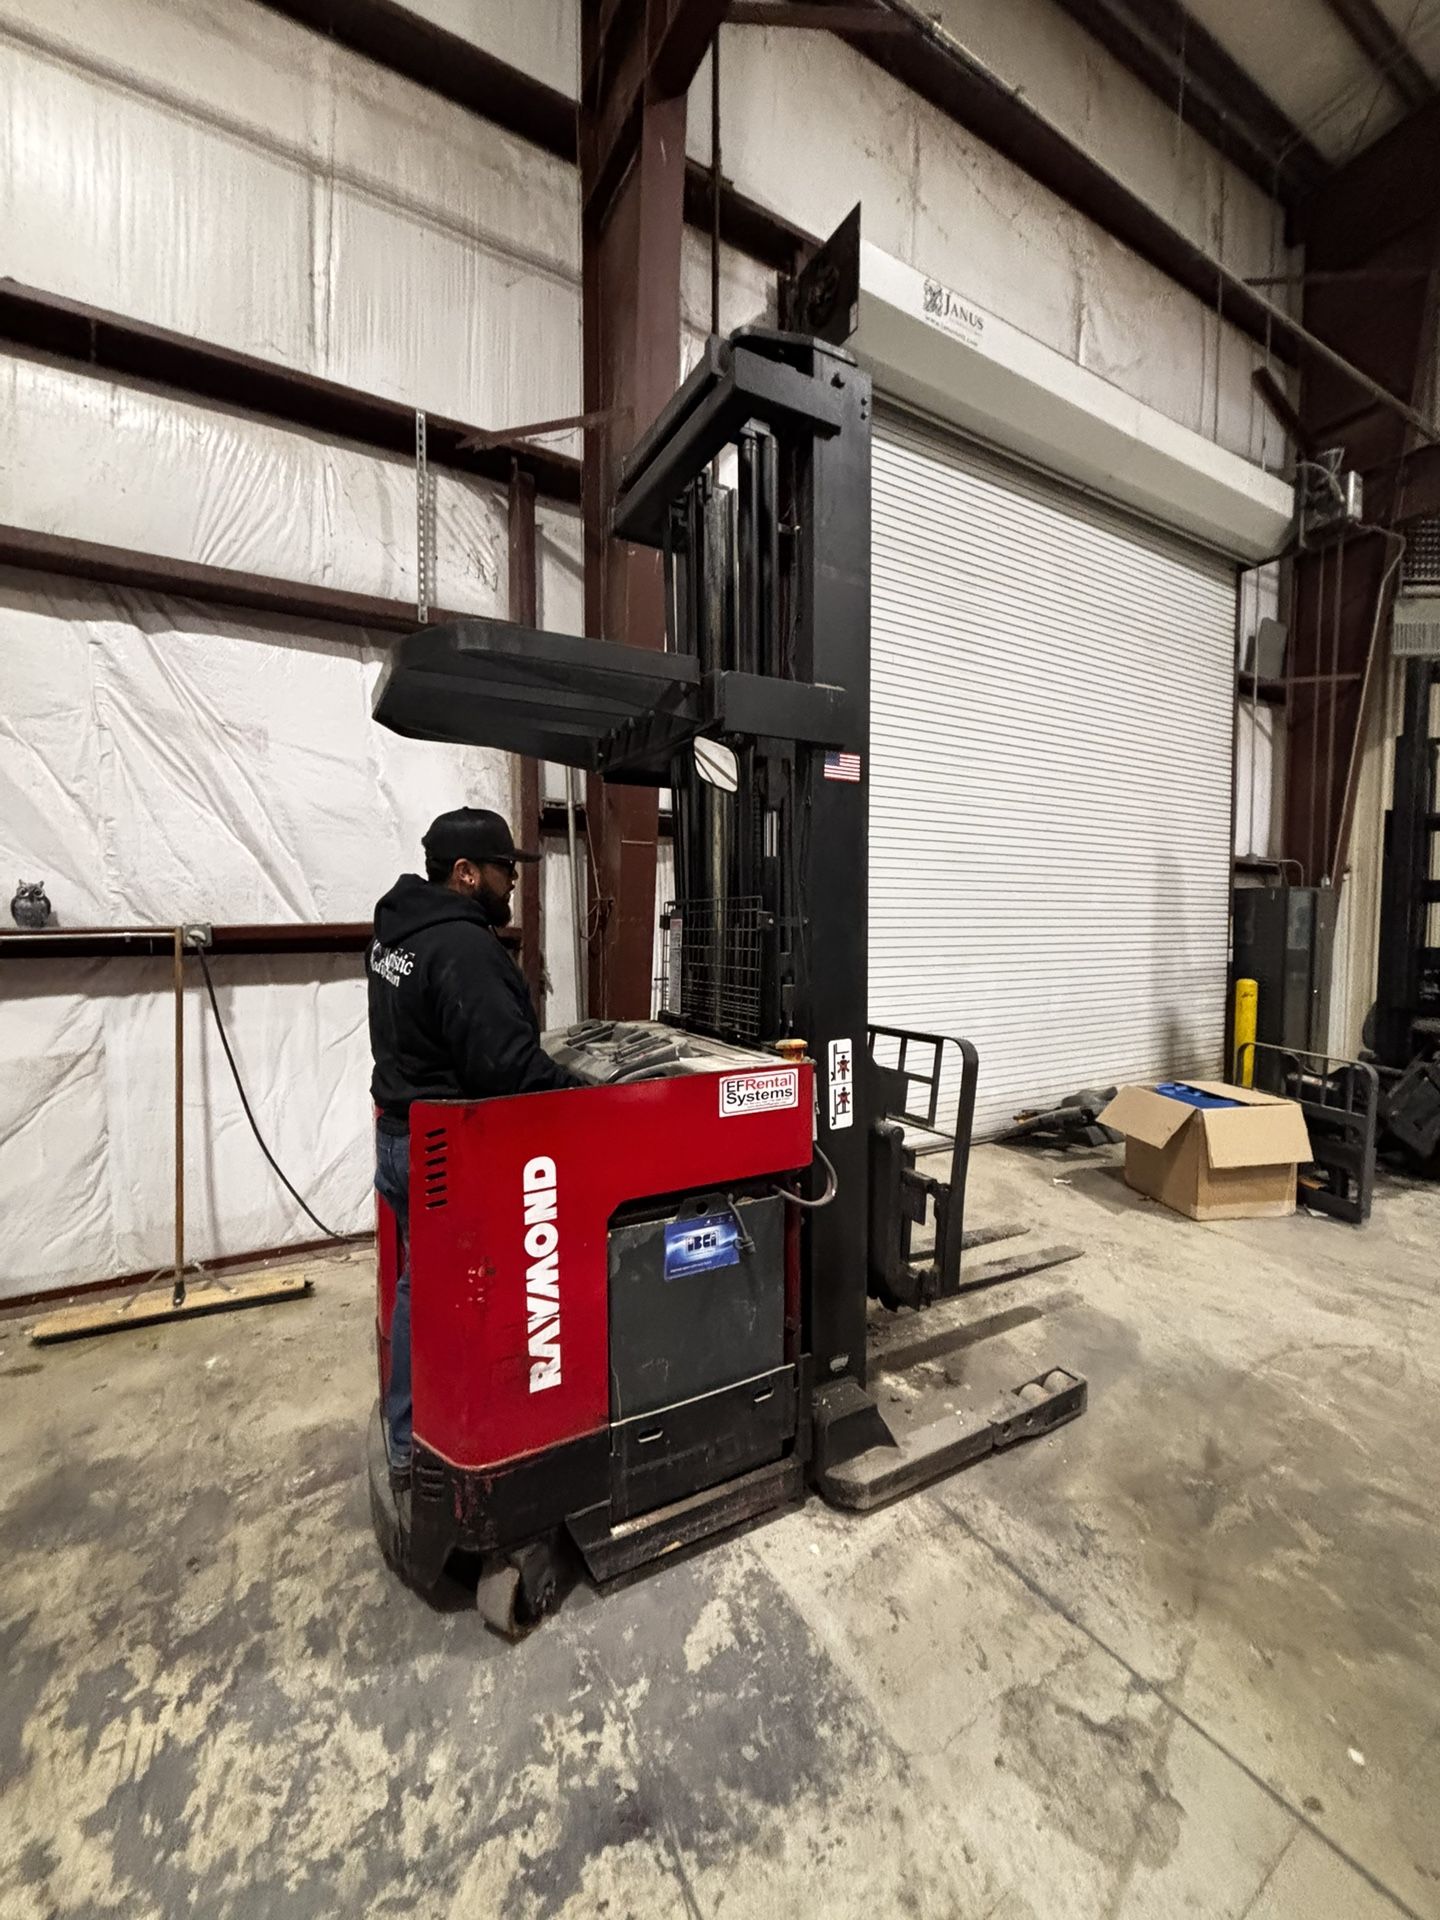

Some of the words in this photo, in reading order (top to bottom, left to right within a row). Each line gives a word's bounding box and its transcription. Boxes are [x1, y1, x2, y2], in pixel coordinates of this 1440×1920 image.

[944, 293, 984, 331] JANUS
[726, 1075, 792, 1093] EFRental
[726, 1087, 793, 1106] Systems
[523, 1156, 562, 1394] RAYMOND
